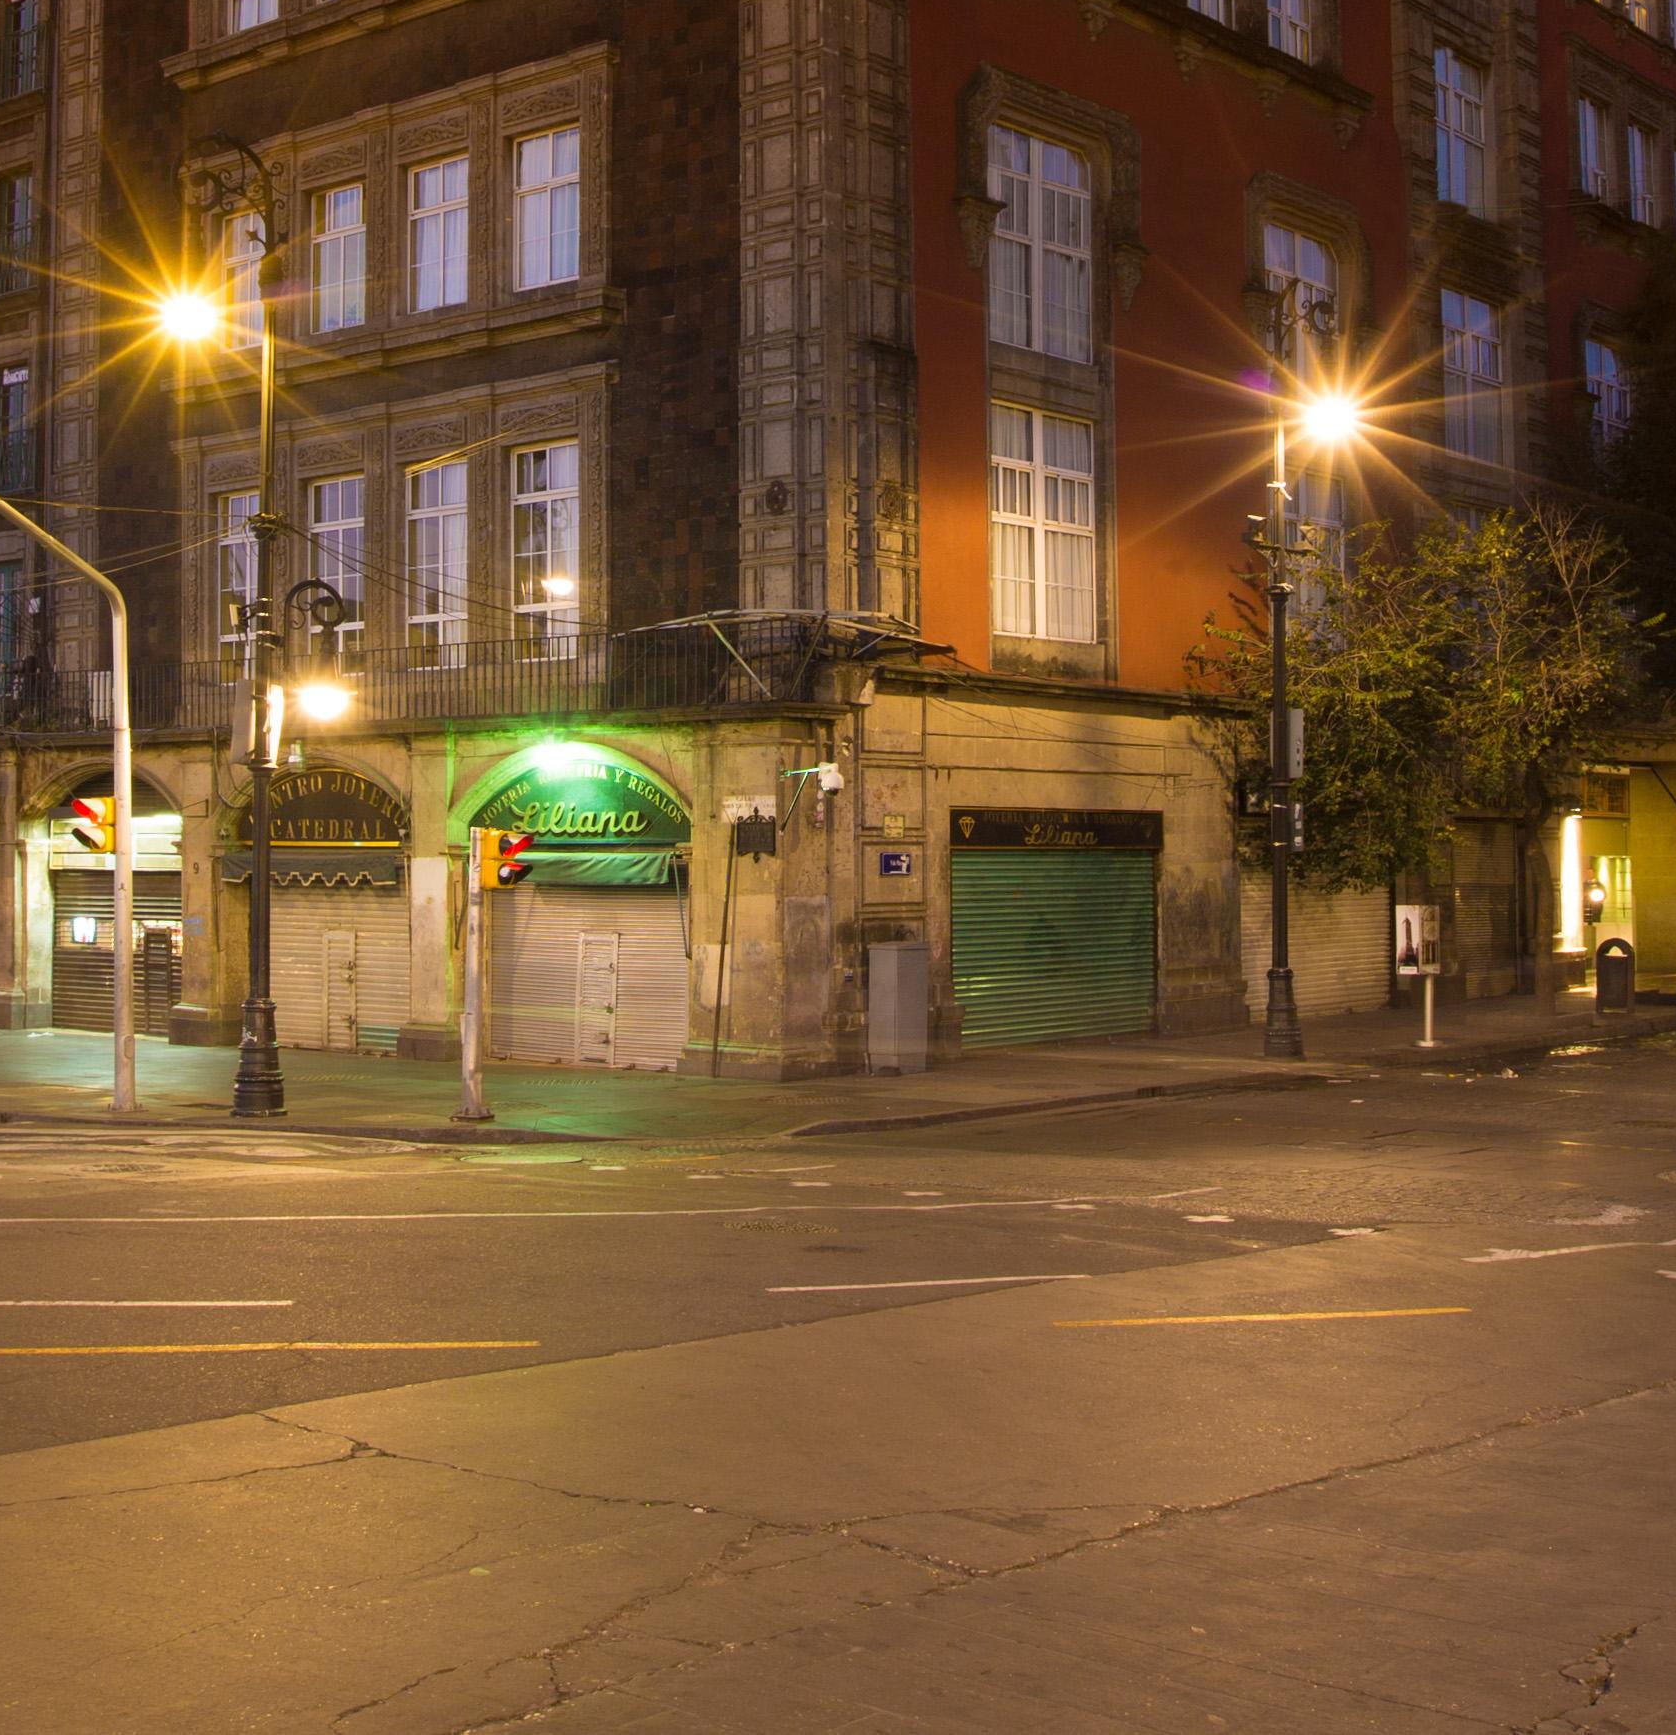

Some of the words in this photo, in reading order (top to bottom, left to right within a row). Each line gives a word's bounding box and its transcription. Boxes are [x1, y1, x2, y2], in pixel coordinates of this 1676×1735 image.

[614, 767, 625, 784] Y
[627, 775, 684, 825] REGALOS
[269, 818, 387, 840] CATEDRAL
[510, 800, 649, 835] Liliana
[1024, 823, 1098, 846] Liliana
